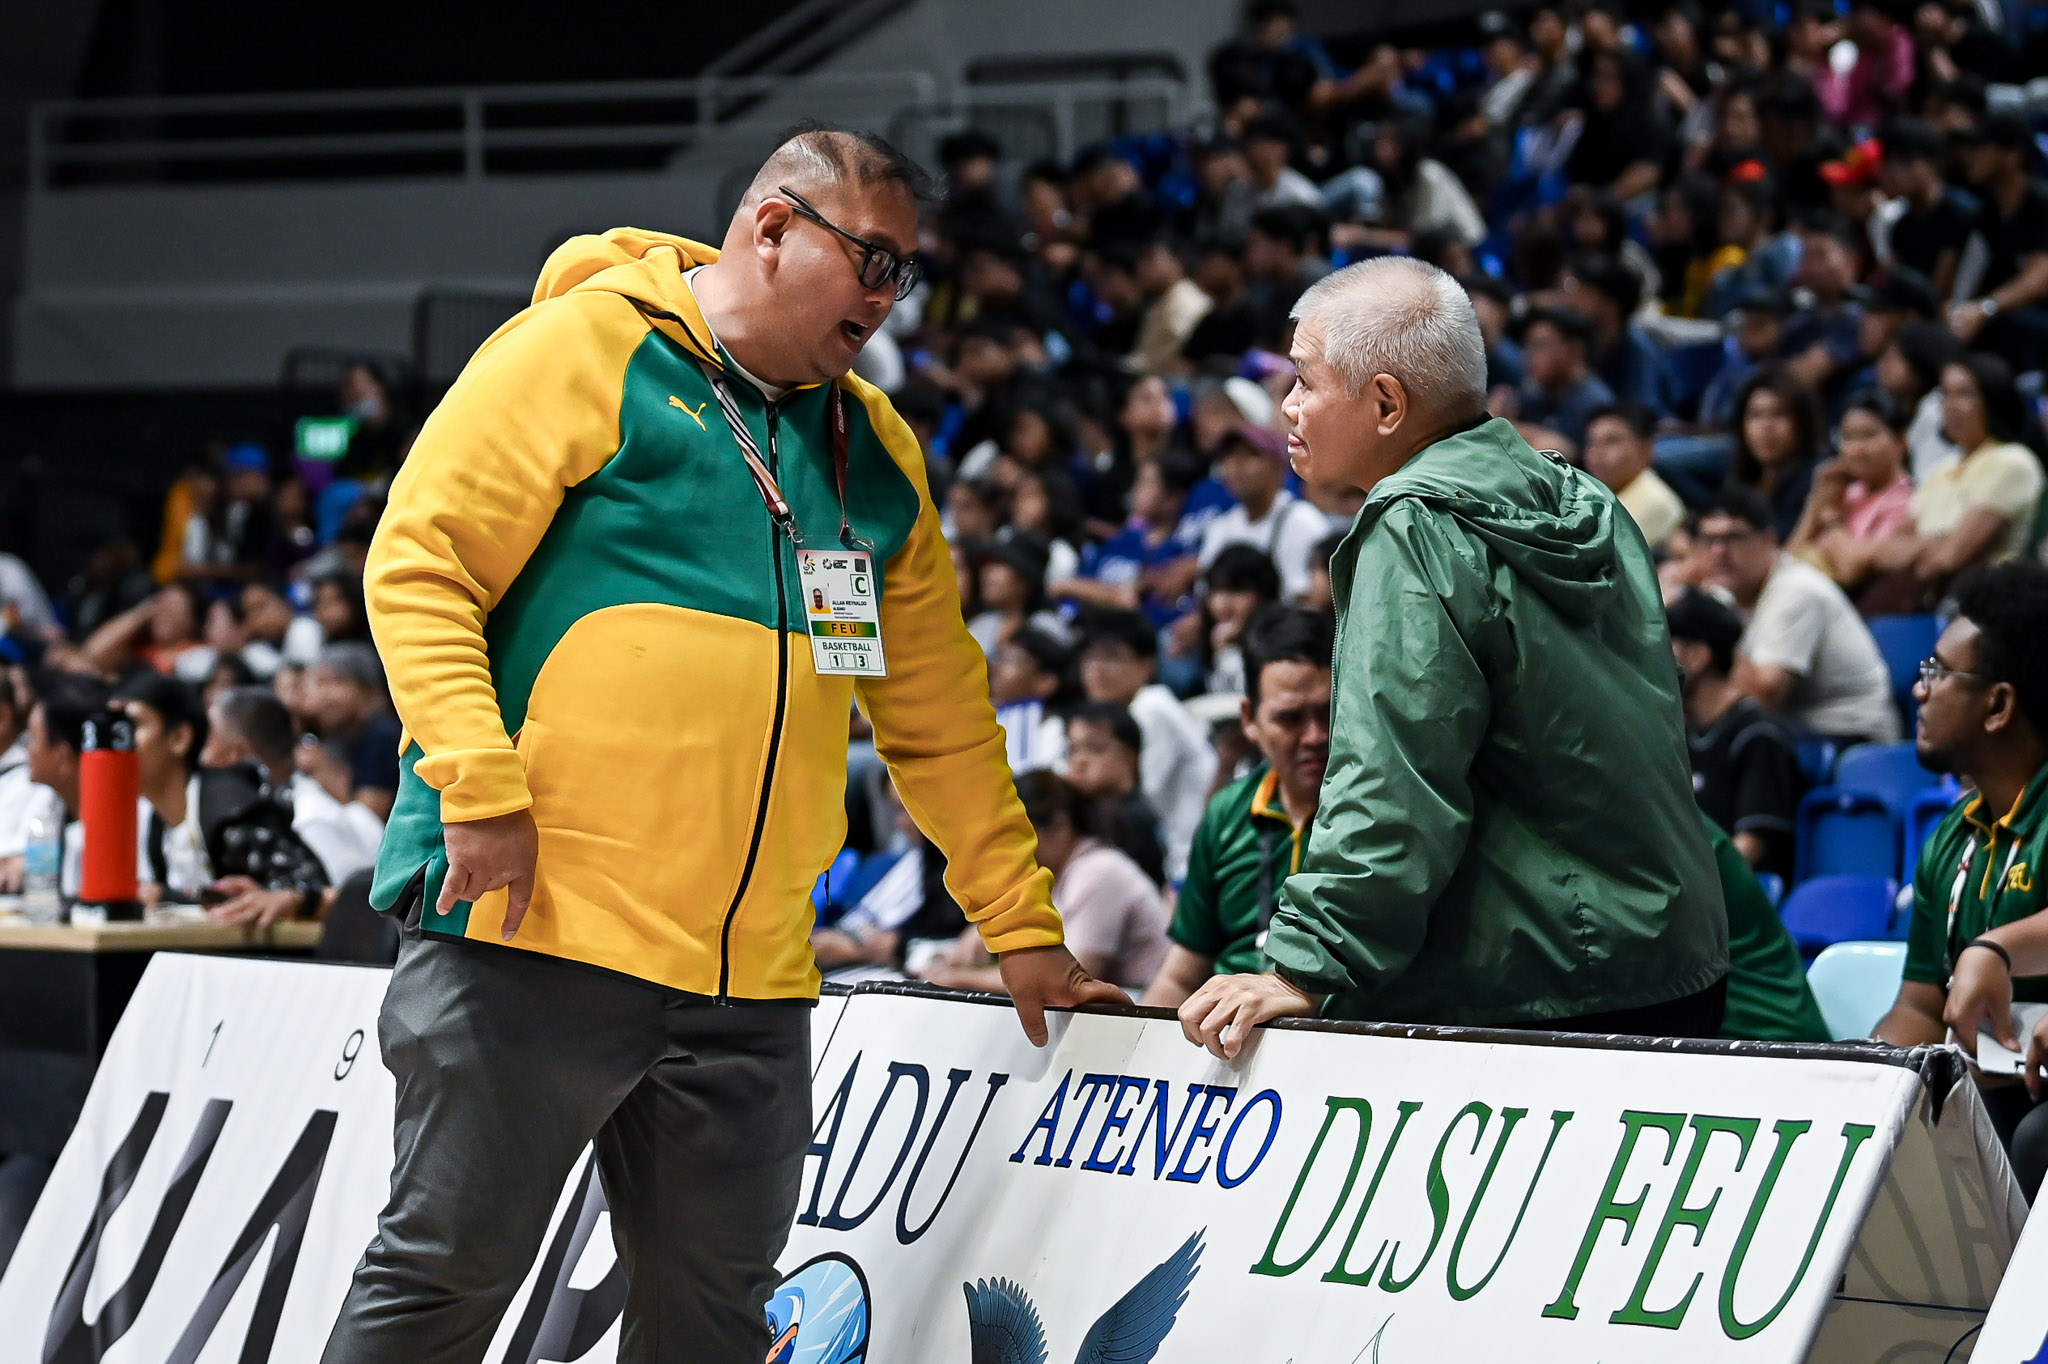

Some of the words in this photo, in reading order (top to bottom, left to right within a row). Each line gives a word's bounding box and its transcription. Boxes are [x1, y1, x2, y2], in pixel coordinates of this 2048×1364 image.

[855, 577, 867, 594] C
[831, 623, 857, 634] FEU
[822, 642, 872, 652] BASKETBALL
[833, 655, 839, 667] 1
[858, 655, 866, 667] 3
[334, 1029, 364, 1081] 9
[796, 1050, 1009, 1245] ADU
[1009, 1067, 1282, 1189] ATENEO
[1249, 1096, 1573, 1301] DLSU
[1542, 1110, 1875, 1340] FEU
